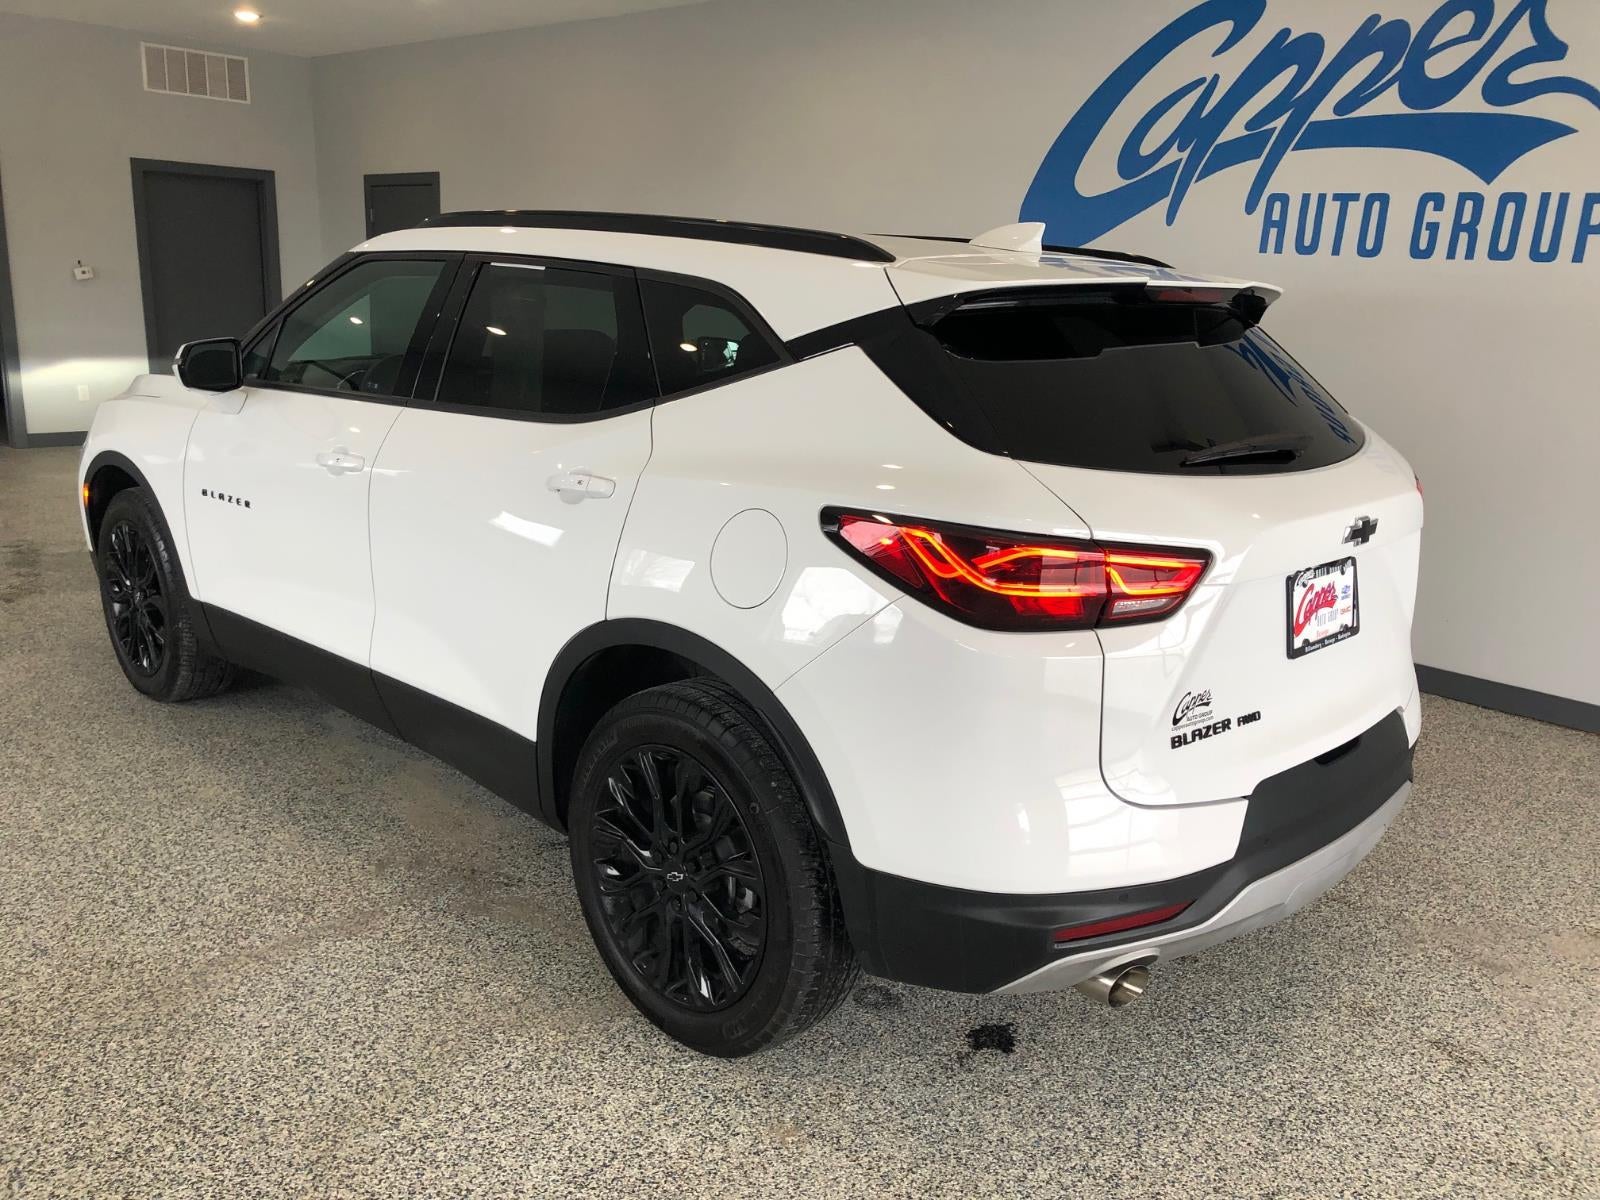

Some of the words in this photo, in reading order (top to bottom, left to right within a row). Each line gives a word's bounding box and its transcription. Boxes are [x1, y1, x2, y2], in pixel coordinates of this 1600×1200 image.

[1259, 192, 1390, 258] AUTO
[1409, 191, 1600, 263] GROUP
[201, 488, 251, 509] BLAZER
[1170, 718, 1232, 750] BLAZER
